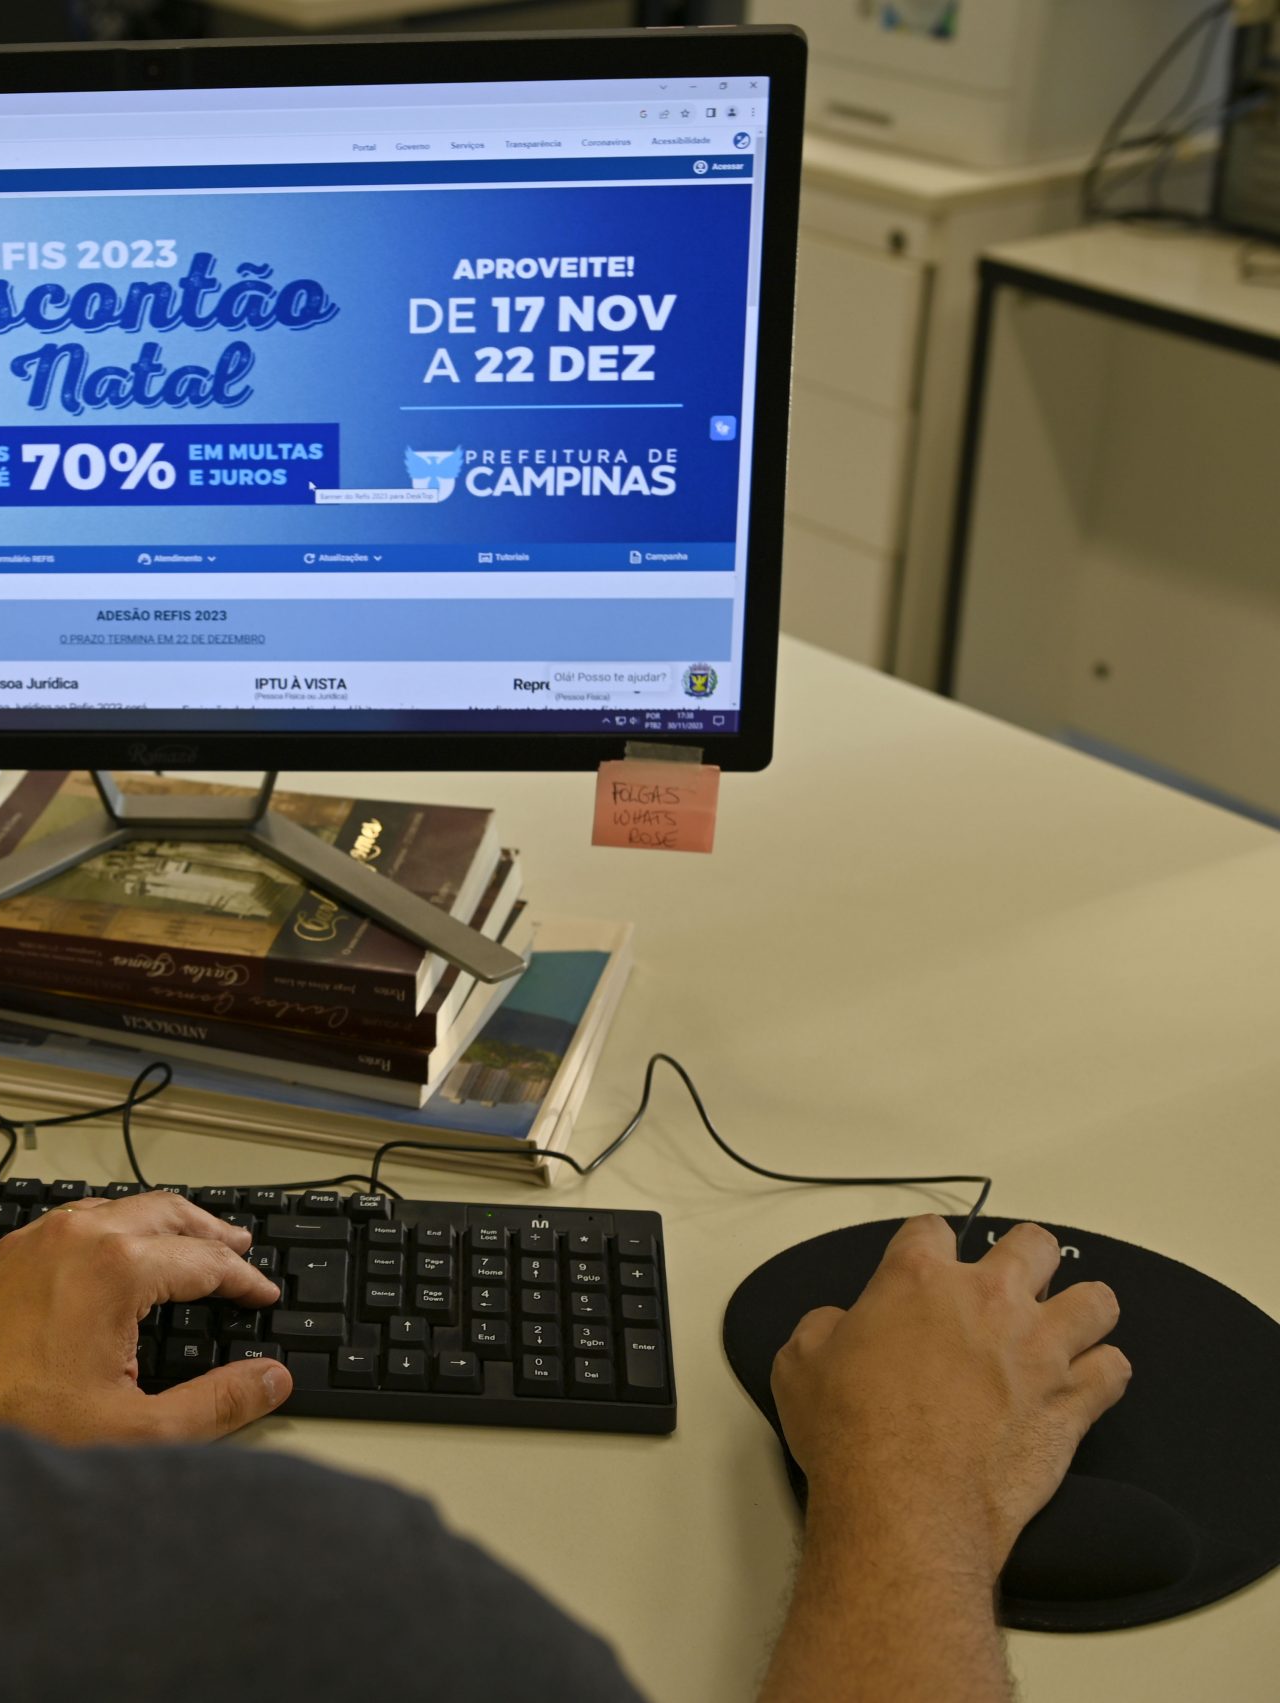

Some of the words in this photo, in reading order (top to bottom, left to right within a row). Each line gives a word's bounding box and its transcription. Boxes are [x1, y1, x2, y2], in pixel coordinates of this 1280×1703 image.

[395, 142, 431, 151] Governo
[450, 141, 485, 151] Serviços
[651, 137, 711, 146] Acessibilidade
[352, 143, 377, 151] Portal
[711, 163, 745, 171] Acessar
[77, 240, 178, 269] 2023
[452, 256, 635, 280] APROVEITE!
[409, 297, 477, 334] DE
[491, 296, 545, 334] 17
[557, 294, 677, 333] NOV
[423, 348, 460, 383] A
[474, 346, 535, 383] 22
[548, 345, 656, 381] DEZ
[9, 340, 256, 416] Natal
[465, 449, 629, 465] PREFEITURA
[648, 448, 678, 464] DE
[21, 443, 176, 491] 70%
[189, 444, 230, 461] EM
[234, 443, 324, 461] MULTAS
[190, 469, 204, 486] E
[208, 469, 288, 486] JUROS
[465, 464, 677, 498] CAMPINAS
[32, 555, 55, 563] REFIS
[154, 554, 203, 563] Atendimento
[319, 553, 369, 564] Atualizações
[495, 552, 530, 561] Tutoriais
[645, 552, 688, 563] Campanha
[96, 607, 150, 621] ADESÃO
[154, 610, 191, 621] REFIS
[195, 610, 228, 621] 2023
[59, 634, 68, 645] O
[70, 634, 105, 645] PRAZO
[108, 634, 155, 645] TERMINA
[157, 634, 174, 645] EM
[175, 634, 189, 645] 22
[191, 634, 206, 645] DE
[208, 633, 266, 645] DEZEMBRO
[26, 676, 79, 689] Jurídica
[255, 678, 288, 690] IPTU
[290, 675, 302, 690] À
[304, 677, 347, 690] VISTA
[554, 671, 575, 682] Olá!
[577, 671, 611, 683] Posso
[614, 672, 624, 682] te
[626, 671, 667, 684] ajudar?
[612, 781, 682, 805] FOLGAS
[613, 809, 677, 827] WHATS
[109, 952, 176, 978] Gomes
[183, 961, 249, 987] Carlos
[121, 1014, 209, 1040] ANTOLOGIA
[357, 1054, 392, 1072] Pontes
[210, 1189, 227, 1197] F11
[481, 1258, 489, 1266] 7
[532, 1260, 540, 1269] 8
[578, 1263, 587, 1271] 9
[478, 1268, 504, 1276] Home
[576, 1273, 601, 1282] PgUp
[423, 1289, 443, 1297] Page
[481, 1289, 490, 1299] 4
[580, 1295, 589, 1303] 6
[478, 1333, 496, 1341] End
[580, 1338, 605, 1347] PgDn
[632, 1343, 656, 1351] Enter
[245, 1350, 263, 1358] Ctrl
[534, 1369, 549, 1377] Ins
[584, 1371, 599, 1379] Del
